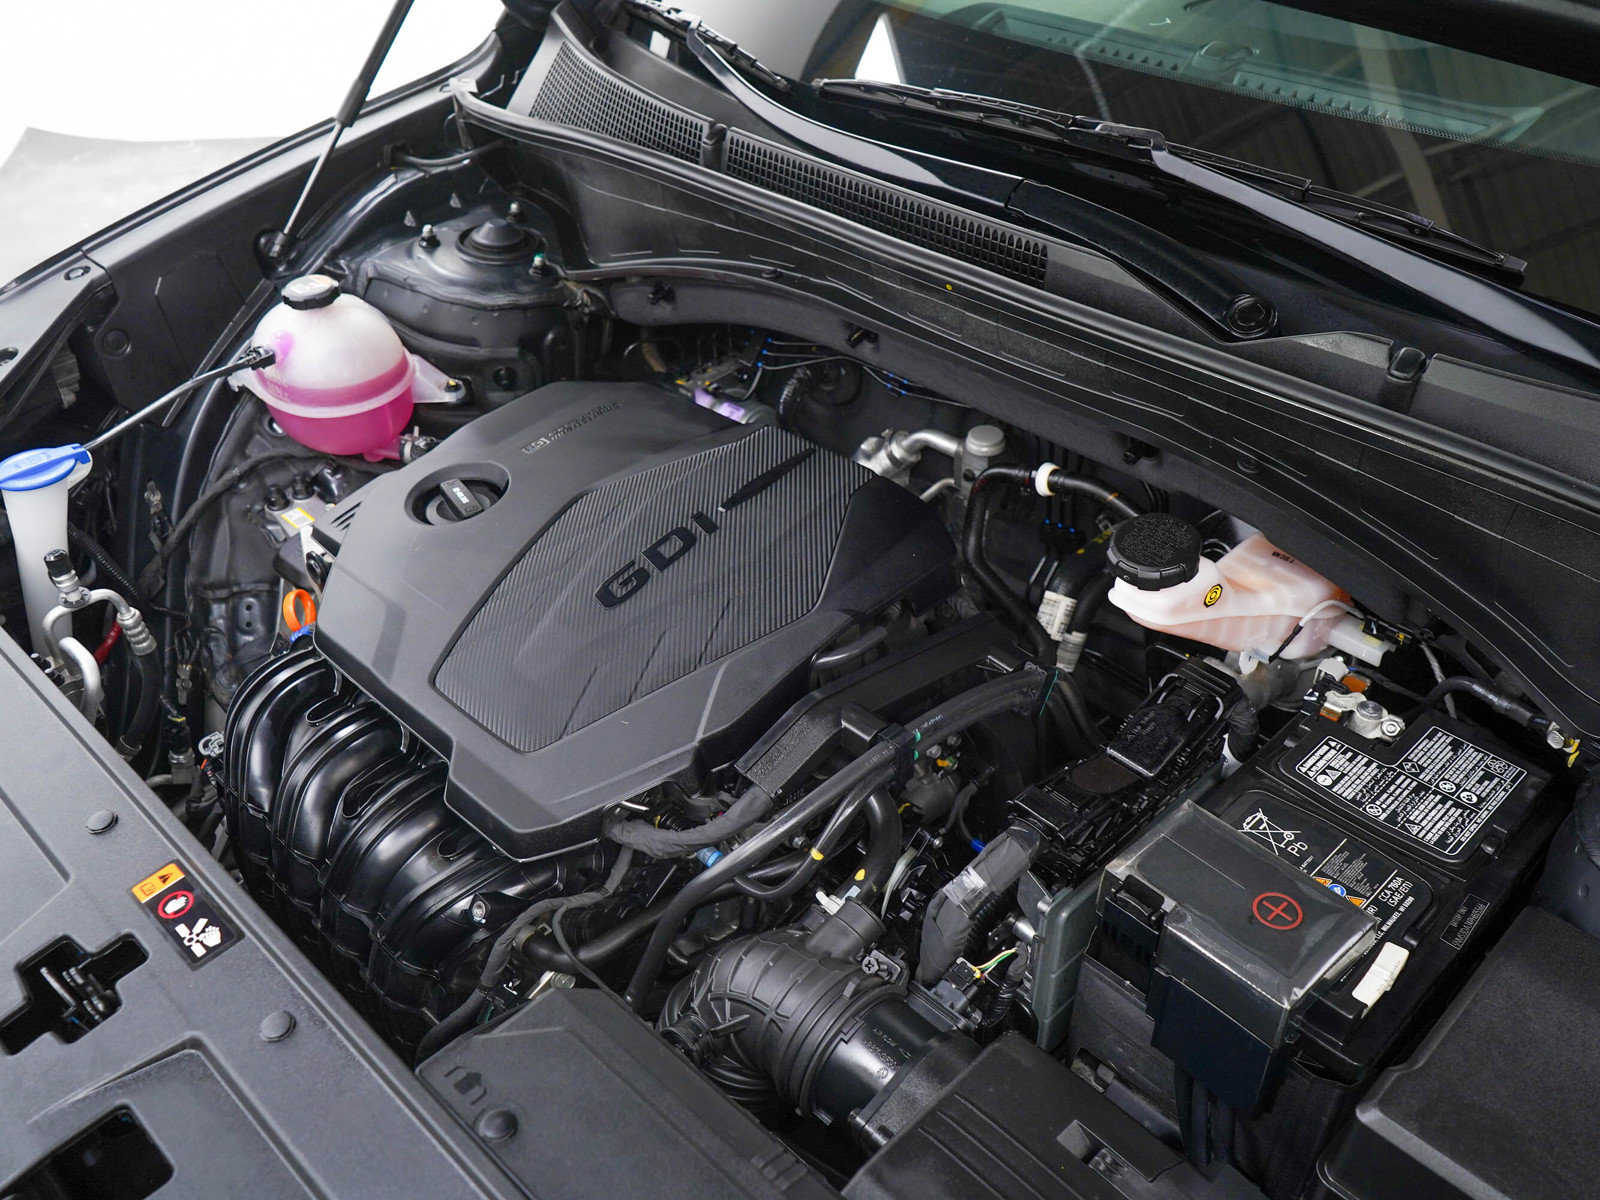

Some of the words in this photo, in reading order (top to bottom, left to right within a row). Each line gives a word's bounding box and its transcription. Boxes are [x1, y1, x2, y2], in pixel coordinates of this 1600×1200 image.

[594, 510, 720, 609] GDI
[1287, 841, 1308, 857] Pb
[1378, 889, 1394, 901] CCA
